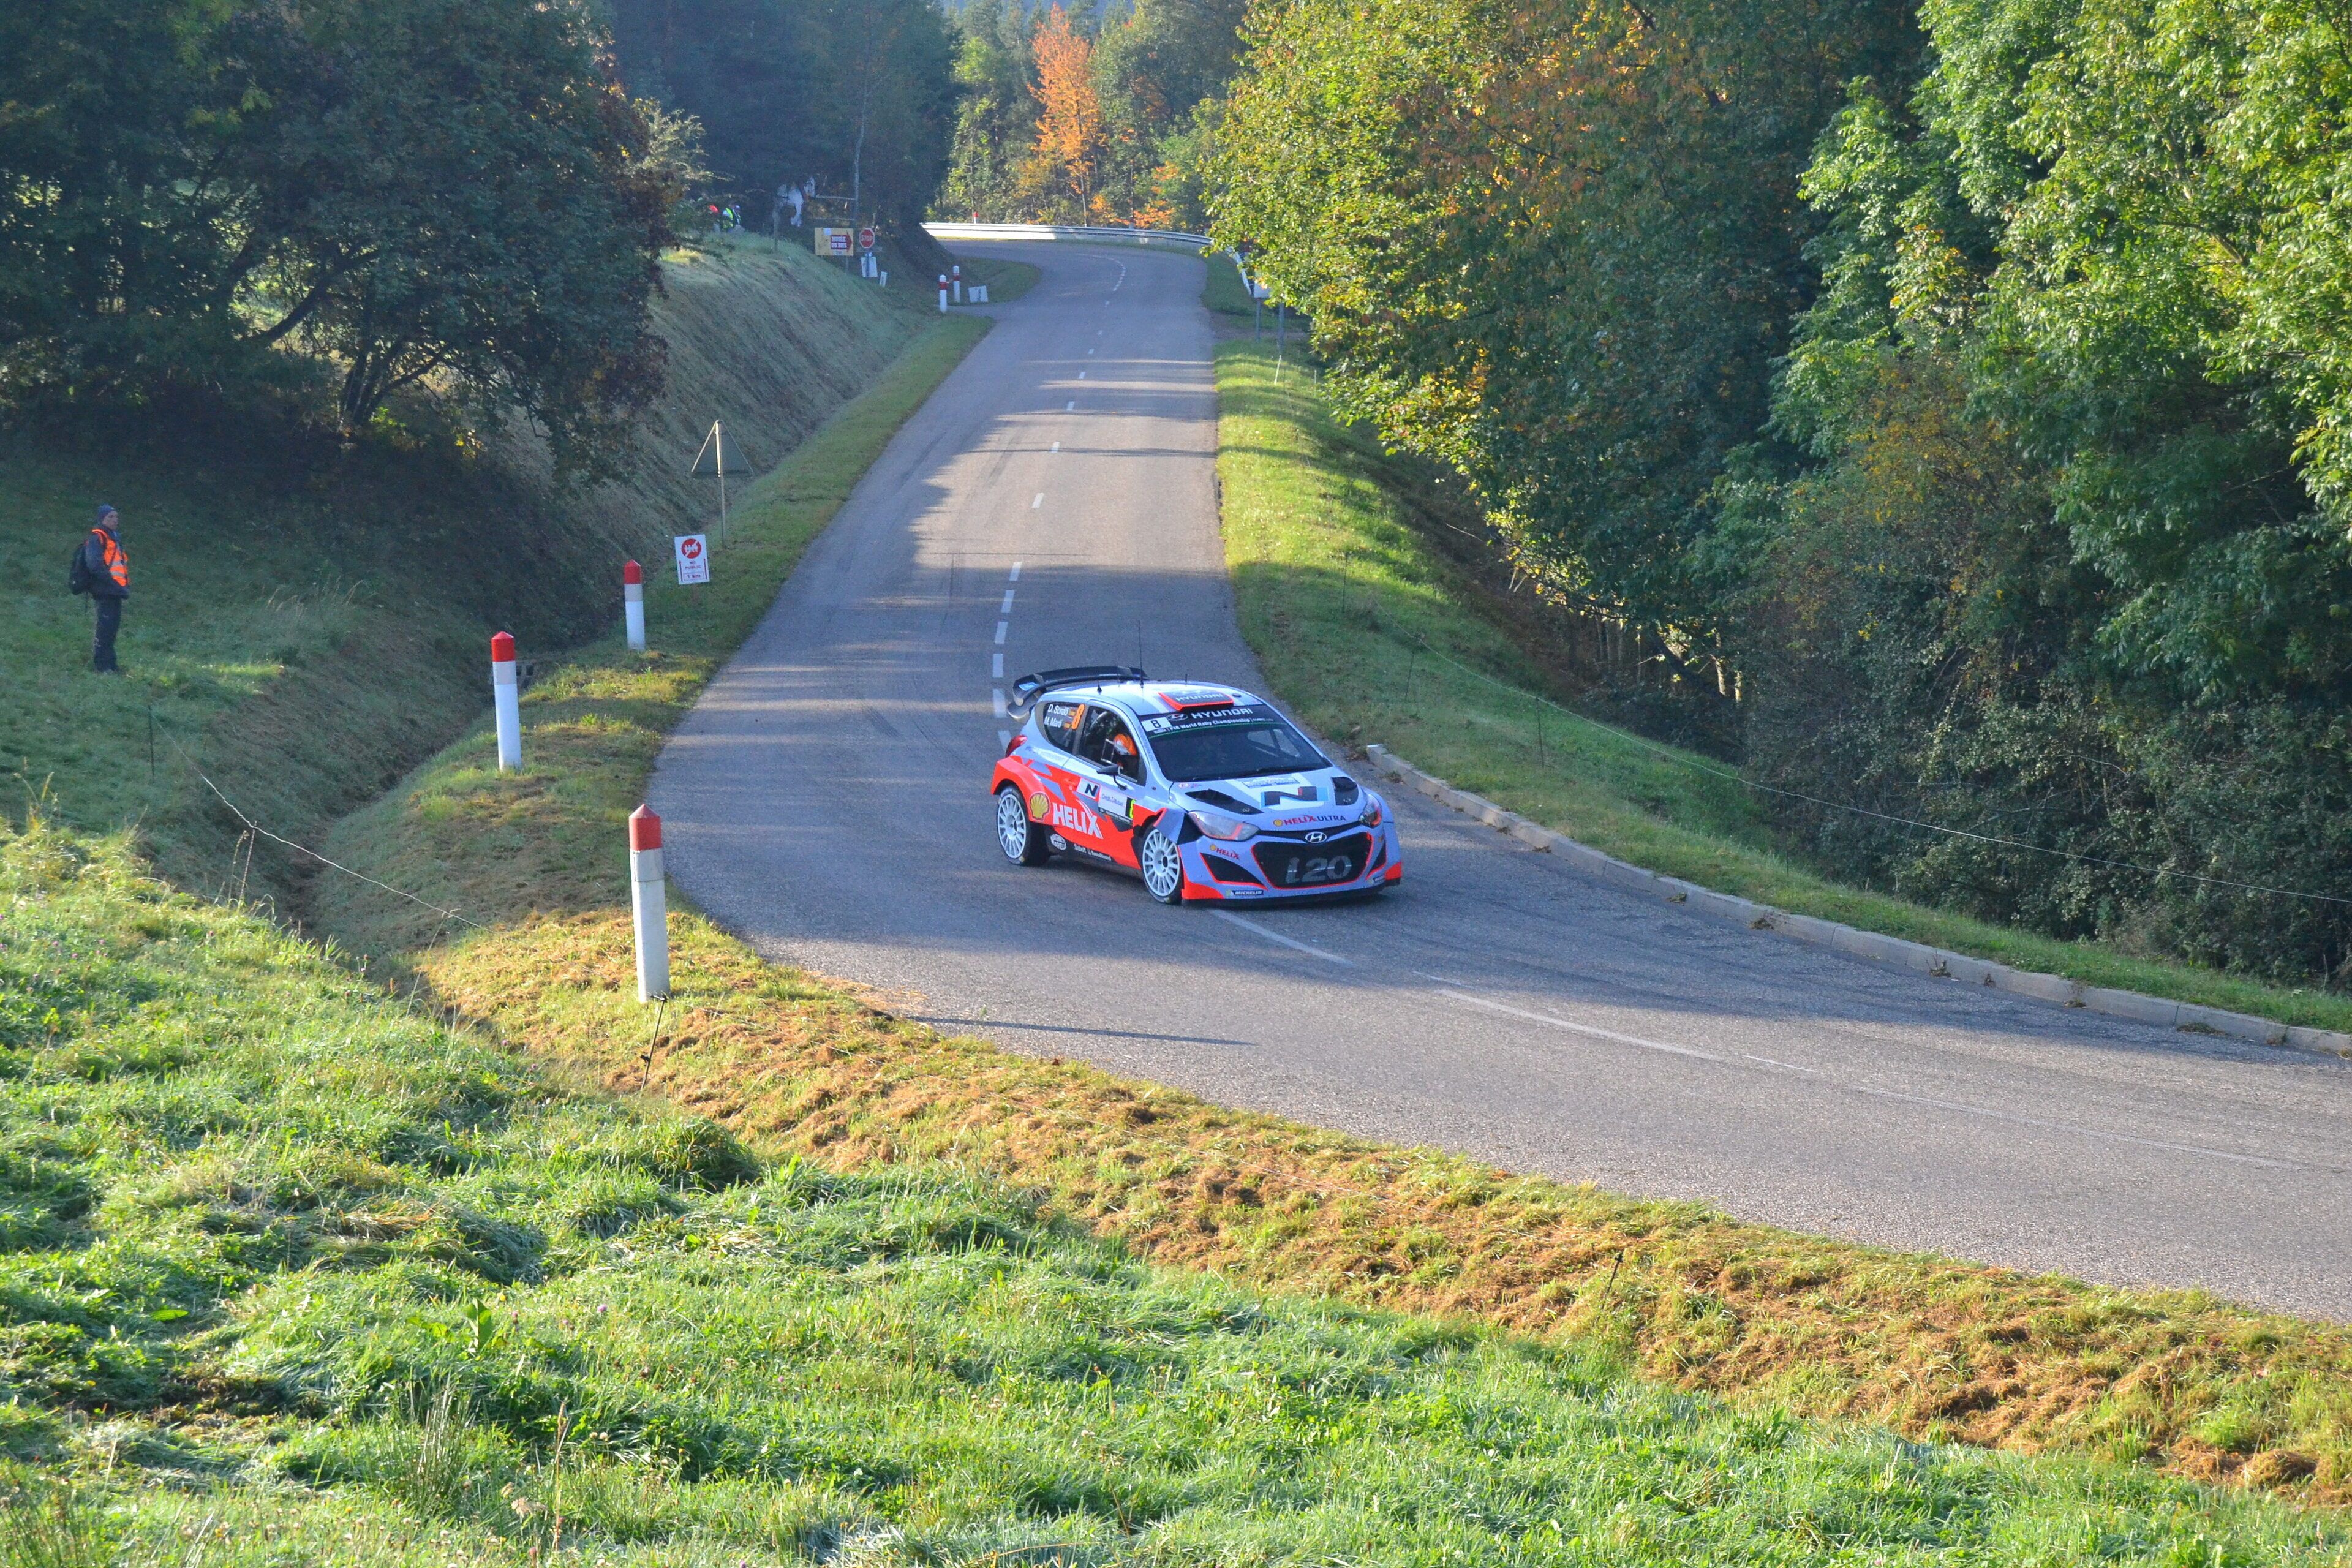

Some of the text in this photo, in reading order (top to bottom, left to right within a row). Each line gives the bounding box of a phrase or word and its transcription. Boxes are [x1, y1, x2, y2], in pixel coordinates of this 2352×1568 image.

[1072, 704, 1085, 729] 8
[1191, 708, 1253, 719] HYUNDAI
[1150, 719, 1161, 729] 8
[1085, 783, 1098, 796] N
[1052, 799, 1104, 839] HELIX
[1283, 815, 1316, 826] HELIX
[1216, 848, 1240, 859] HELIX
